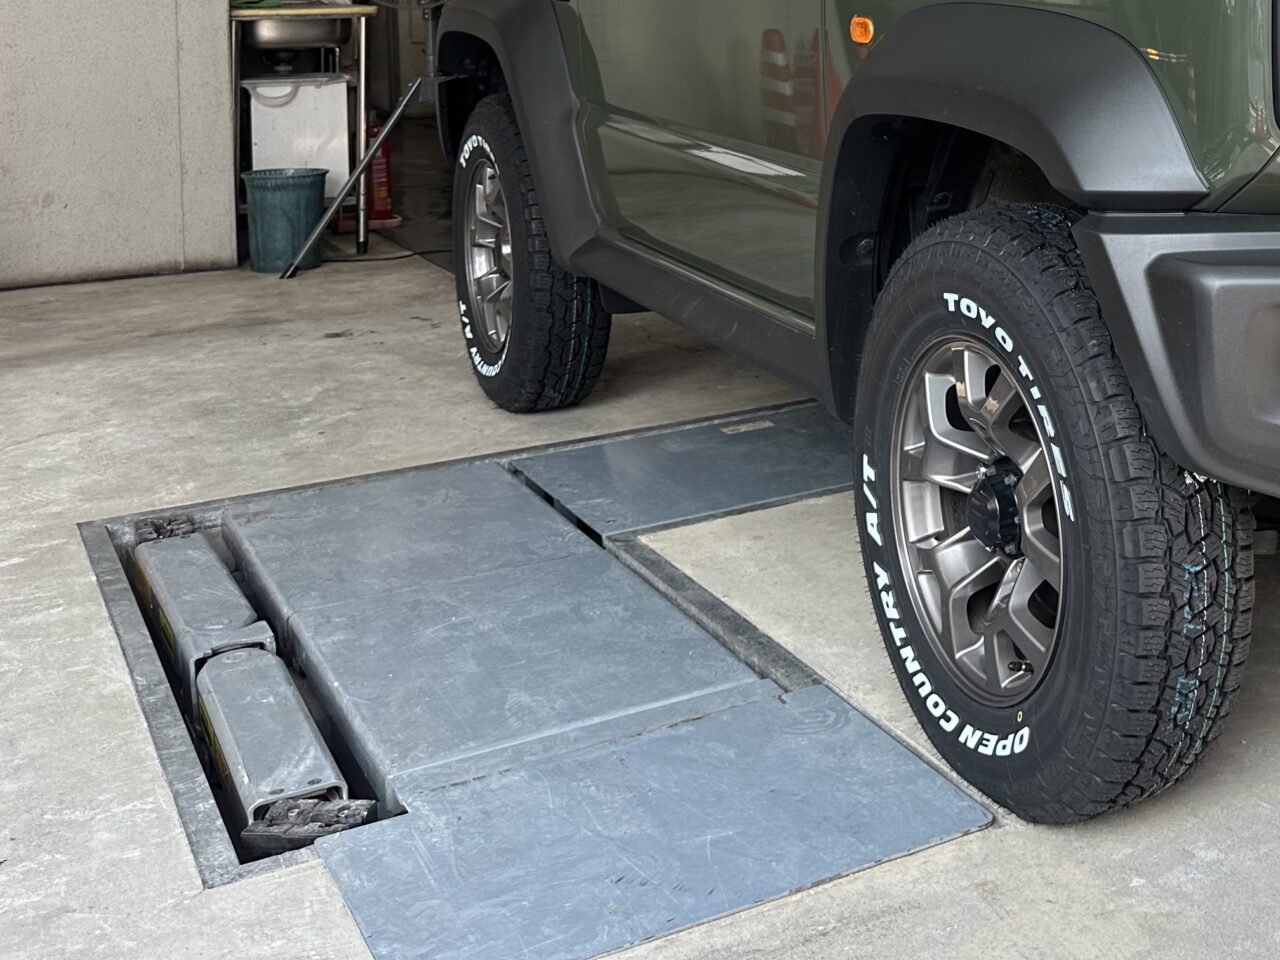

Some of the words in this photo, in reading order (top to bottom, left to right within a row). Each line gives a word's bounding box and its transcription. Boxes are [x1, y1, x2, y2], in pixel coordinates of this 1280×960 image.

[460, 135, 478, 168] TOYO
[460, 300, 473, 338] A/T
[943, 292, 1014, 352] TOYO
[1017, 356, 1074, 522] TIRES
[863, 453, 883, 547] A/T
[873, 560, 960, 733] COUNTRY
[958, 725, 1029, 757] OPEN
